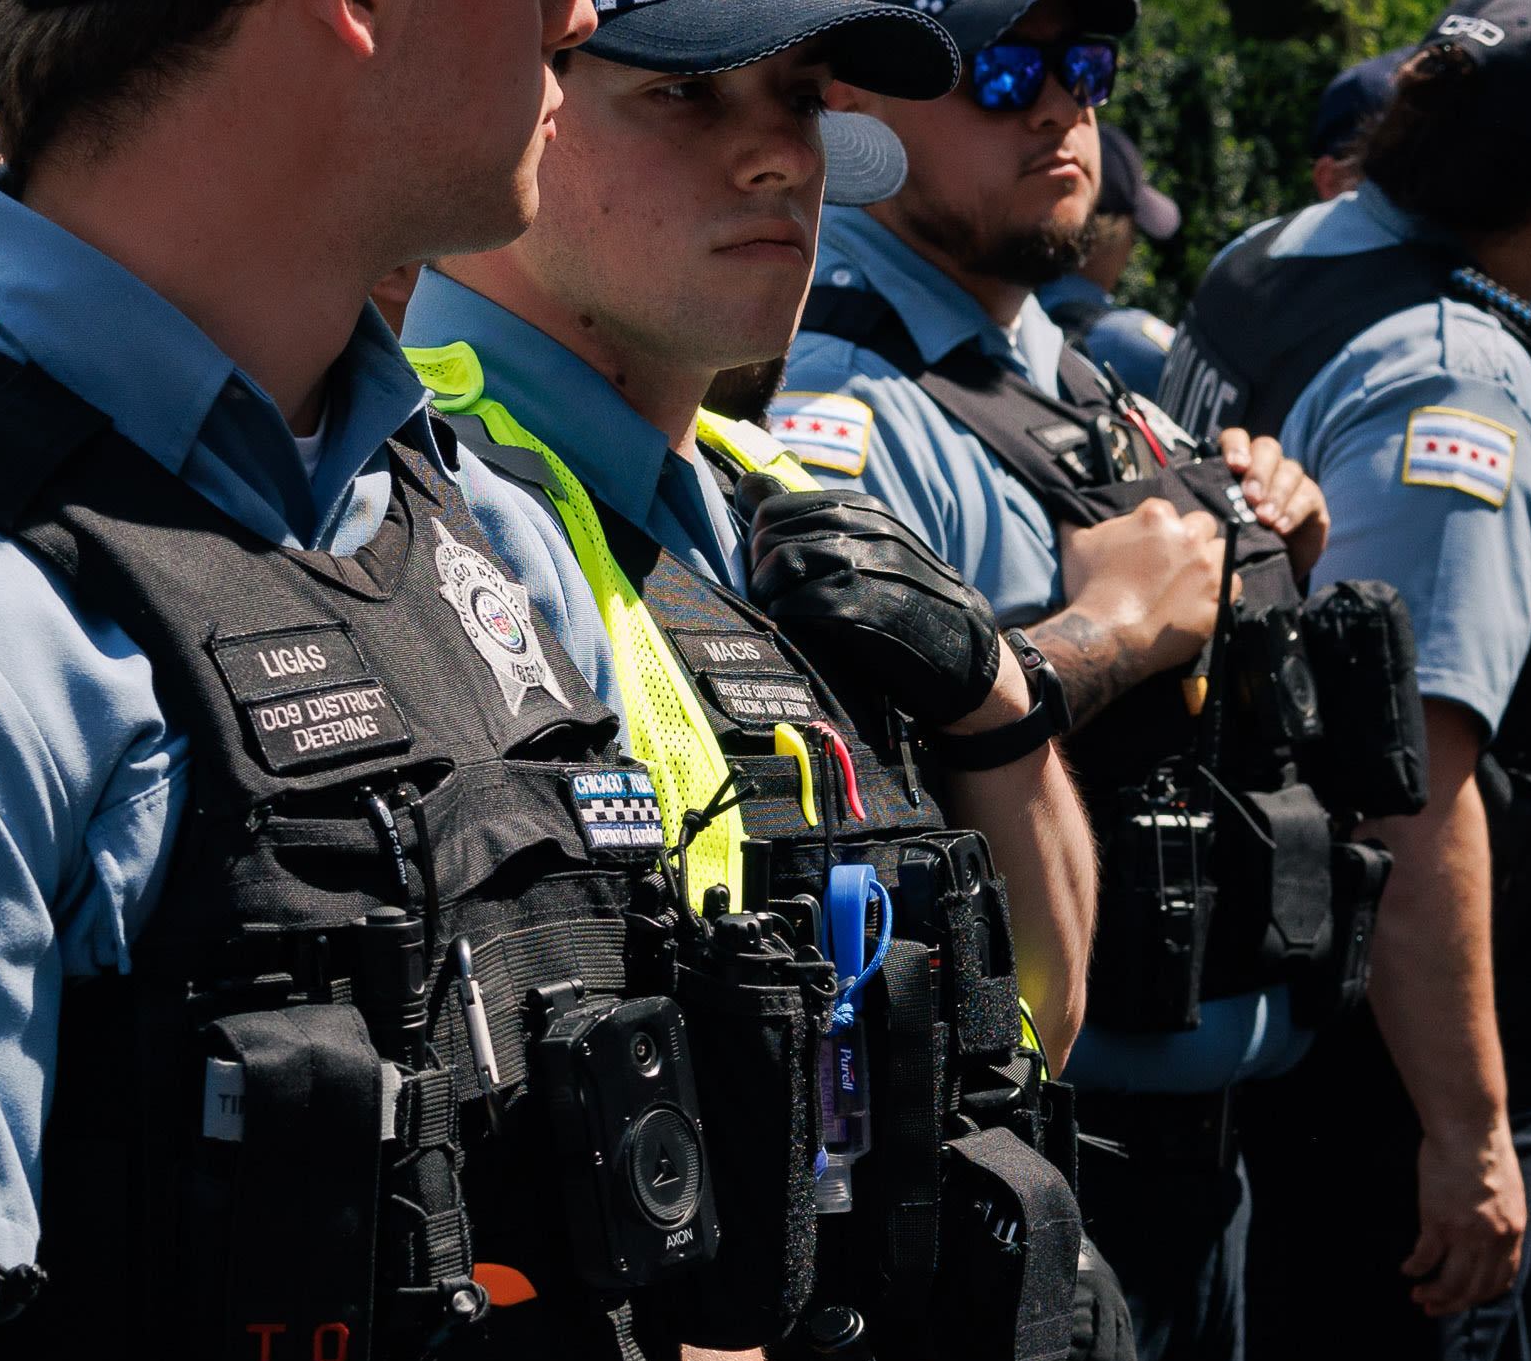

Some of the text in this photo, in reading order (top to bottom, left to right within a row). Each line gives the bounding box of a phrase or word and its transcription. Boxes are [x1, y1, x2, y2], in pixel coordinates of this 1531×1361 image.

[1438, 14, 1505, 47] CPD
[452, 563, 530, 638] CHICAGO POLICE
[258, 644, 327, 678] LIGAS
[702, 641, 761, 662] MACIS
[260, 687, 386, 731] 009 DISTRICT
[292, 714, 380, 752] DEERING
[573, 773, 623, 795] CHICAGO
[389, 828, 403, 856] G-2
[840, 1047, 855, 1092] Purell
[666, 1227, 694, 1250] AXON
